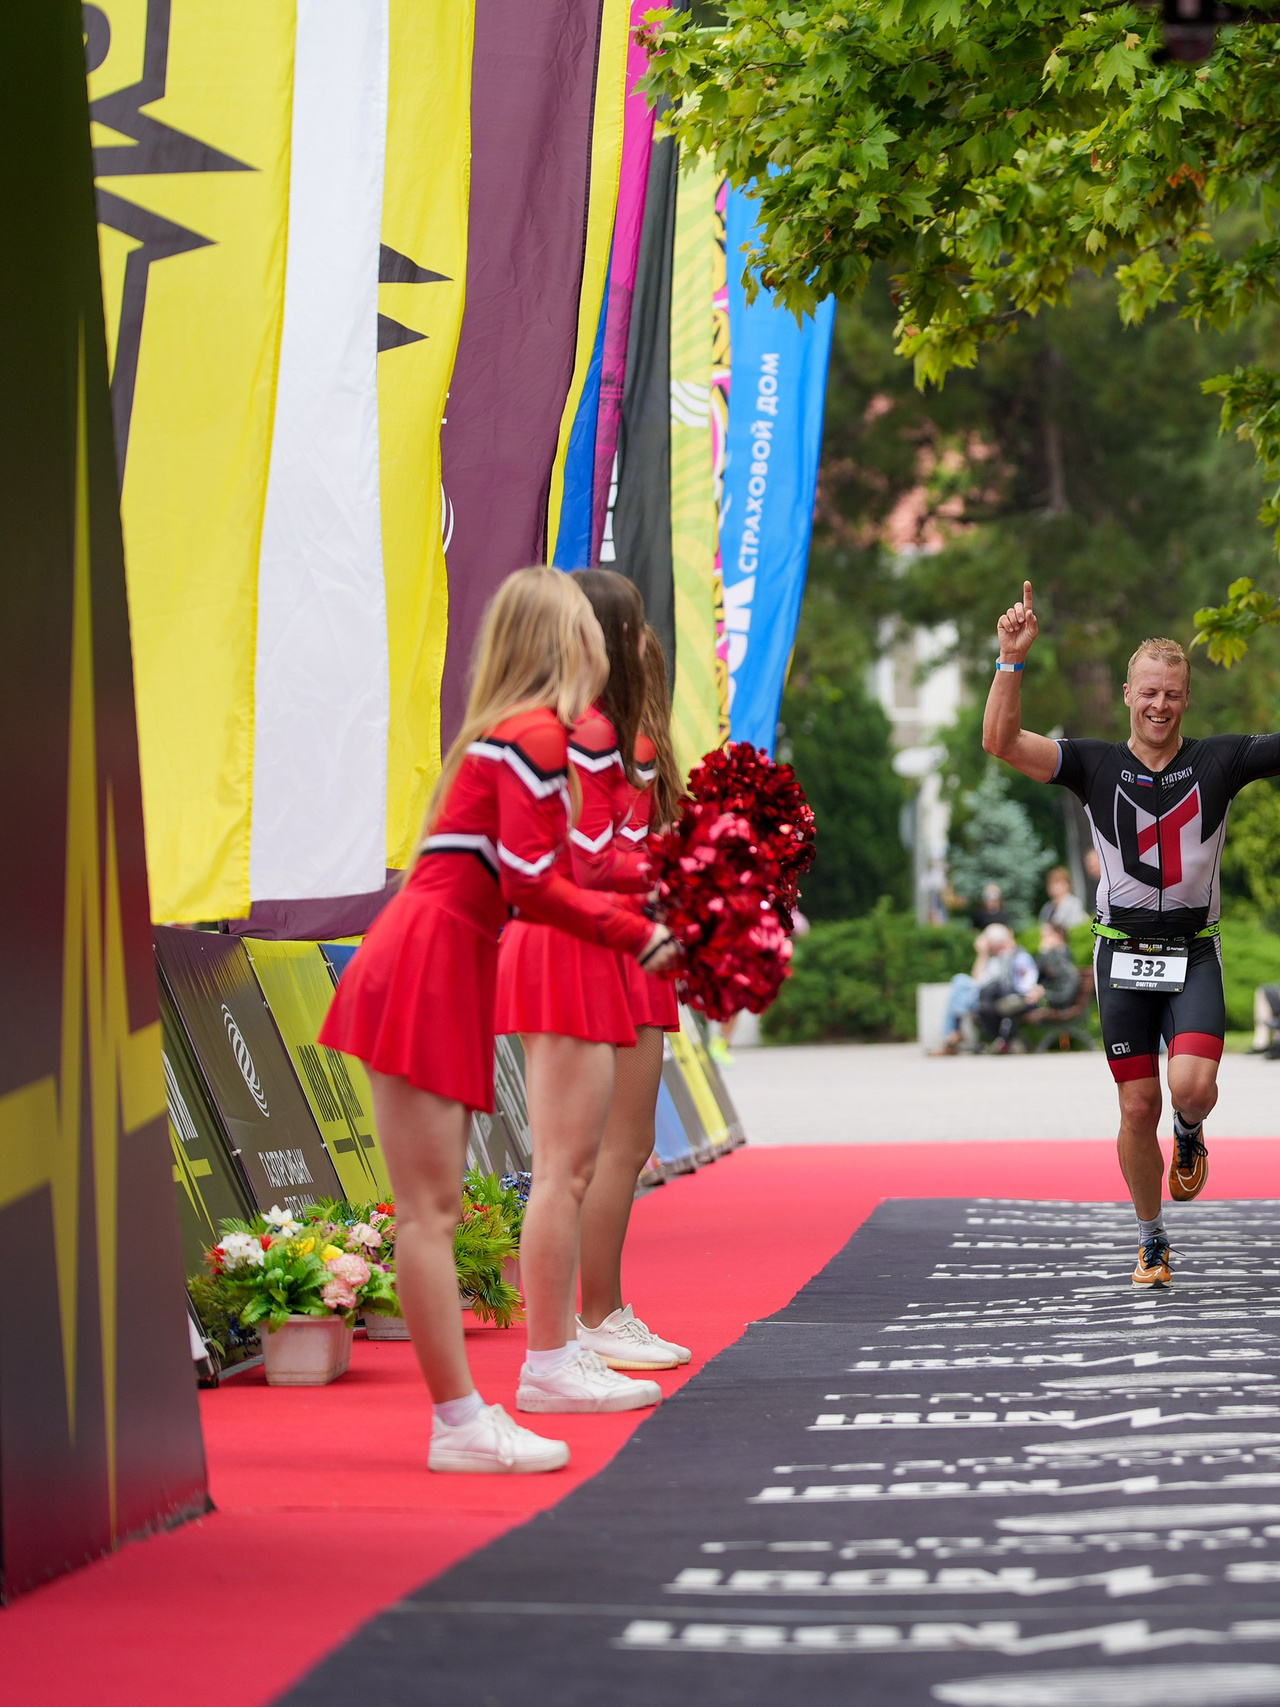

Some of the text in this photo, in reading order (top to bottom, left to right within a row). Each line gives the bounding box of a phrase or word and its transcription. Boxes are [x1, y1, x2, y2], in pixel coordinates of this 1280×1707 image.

[738, 420, 774, 574] СТРАХОВОЙ
[756, 351, 781, 417] ДОМ
[1131, 958, 1166, 978] 332
[855, 1353, 1084, 1369] IRON
[814, 1409, 1076, 1426] IRON
[760, 1479, 1060, 1501] IRON
[674, 1567, 1036, 1592] IRON
[622, 1619, 1020, 1649] IRON
